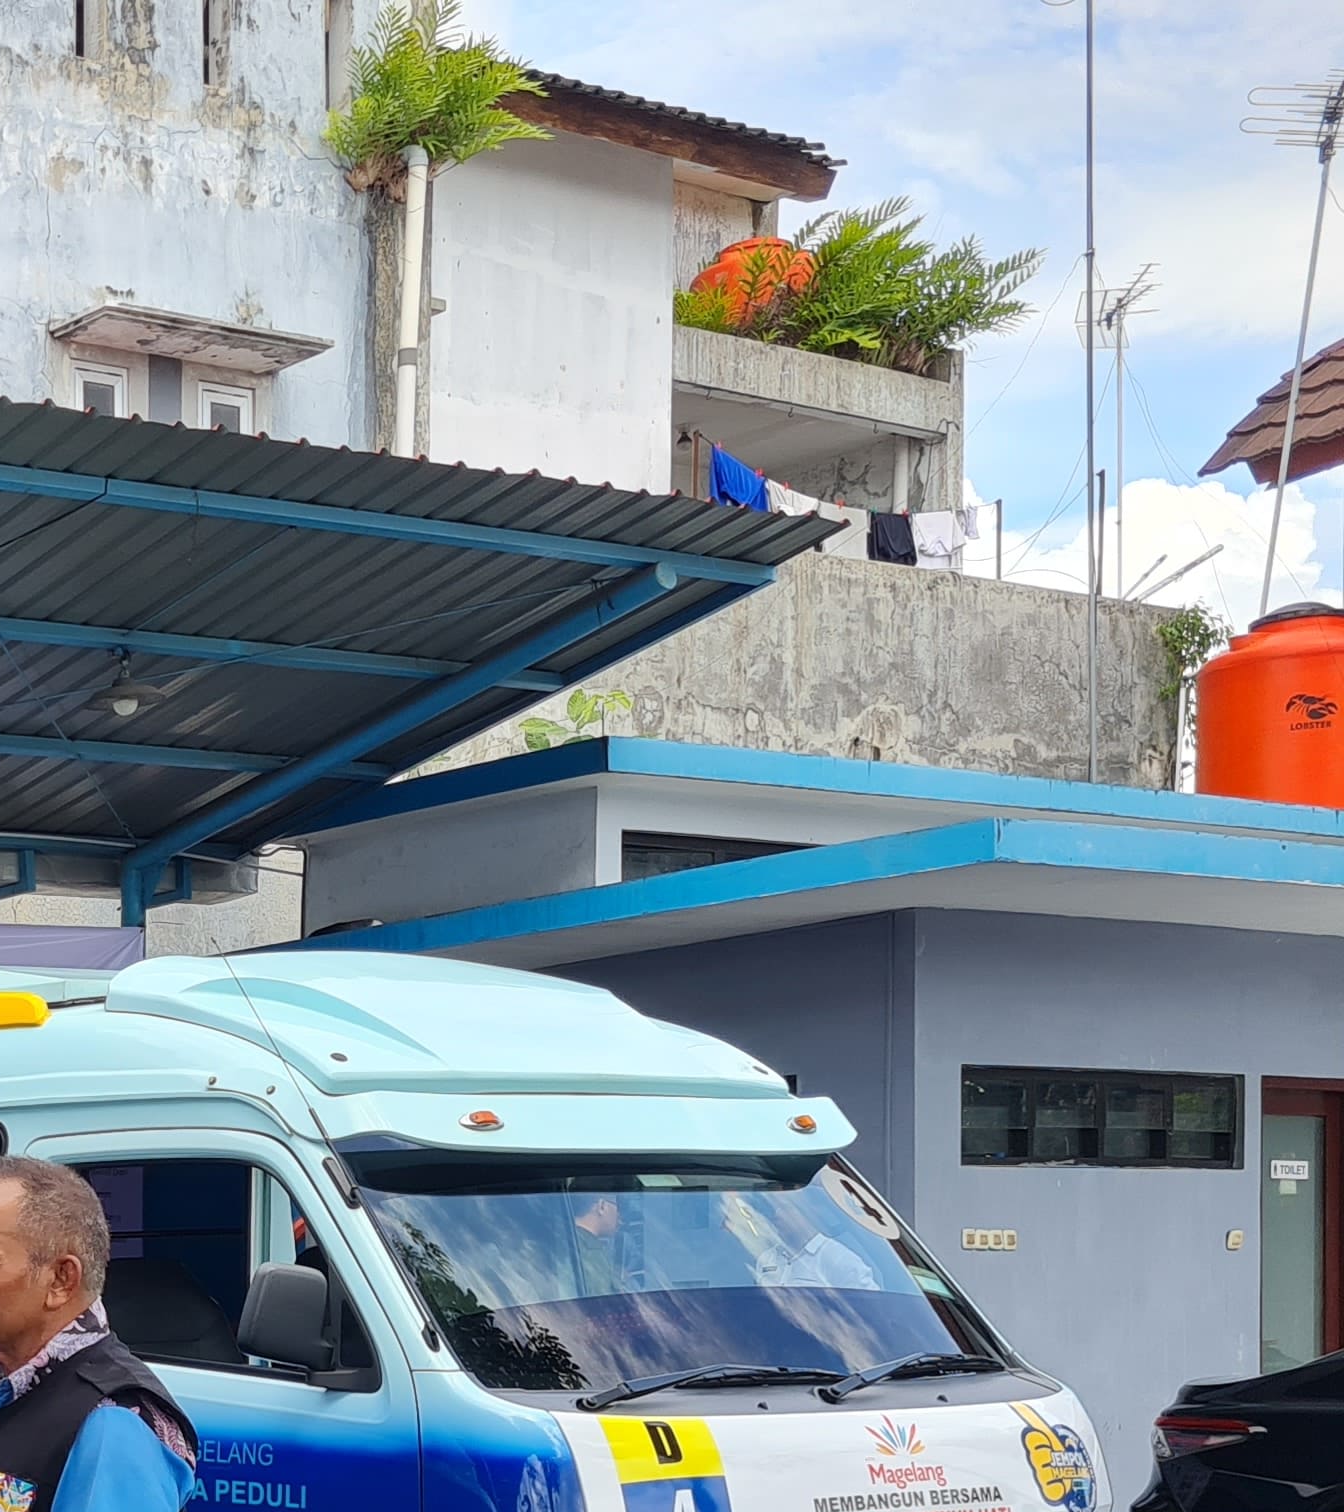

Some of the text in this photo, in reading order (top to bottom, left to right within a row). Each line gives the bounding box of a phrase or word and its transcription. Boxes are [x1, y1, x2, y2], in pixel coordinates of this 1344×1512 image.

[1290, 721, 1332, 731] LOBSTER
[1279, 1165, 1306, 1175] TOILET
[195, 1439, 274, 1466] ELANG
[643, 1420, 683, 1464] D
[867, 1461, 948, 1490] Magelang
[215, 1479, 307, 1509] PEDULI
[930, 1486, 1004, 1506] BERSAMA
